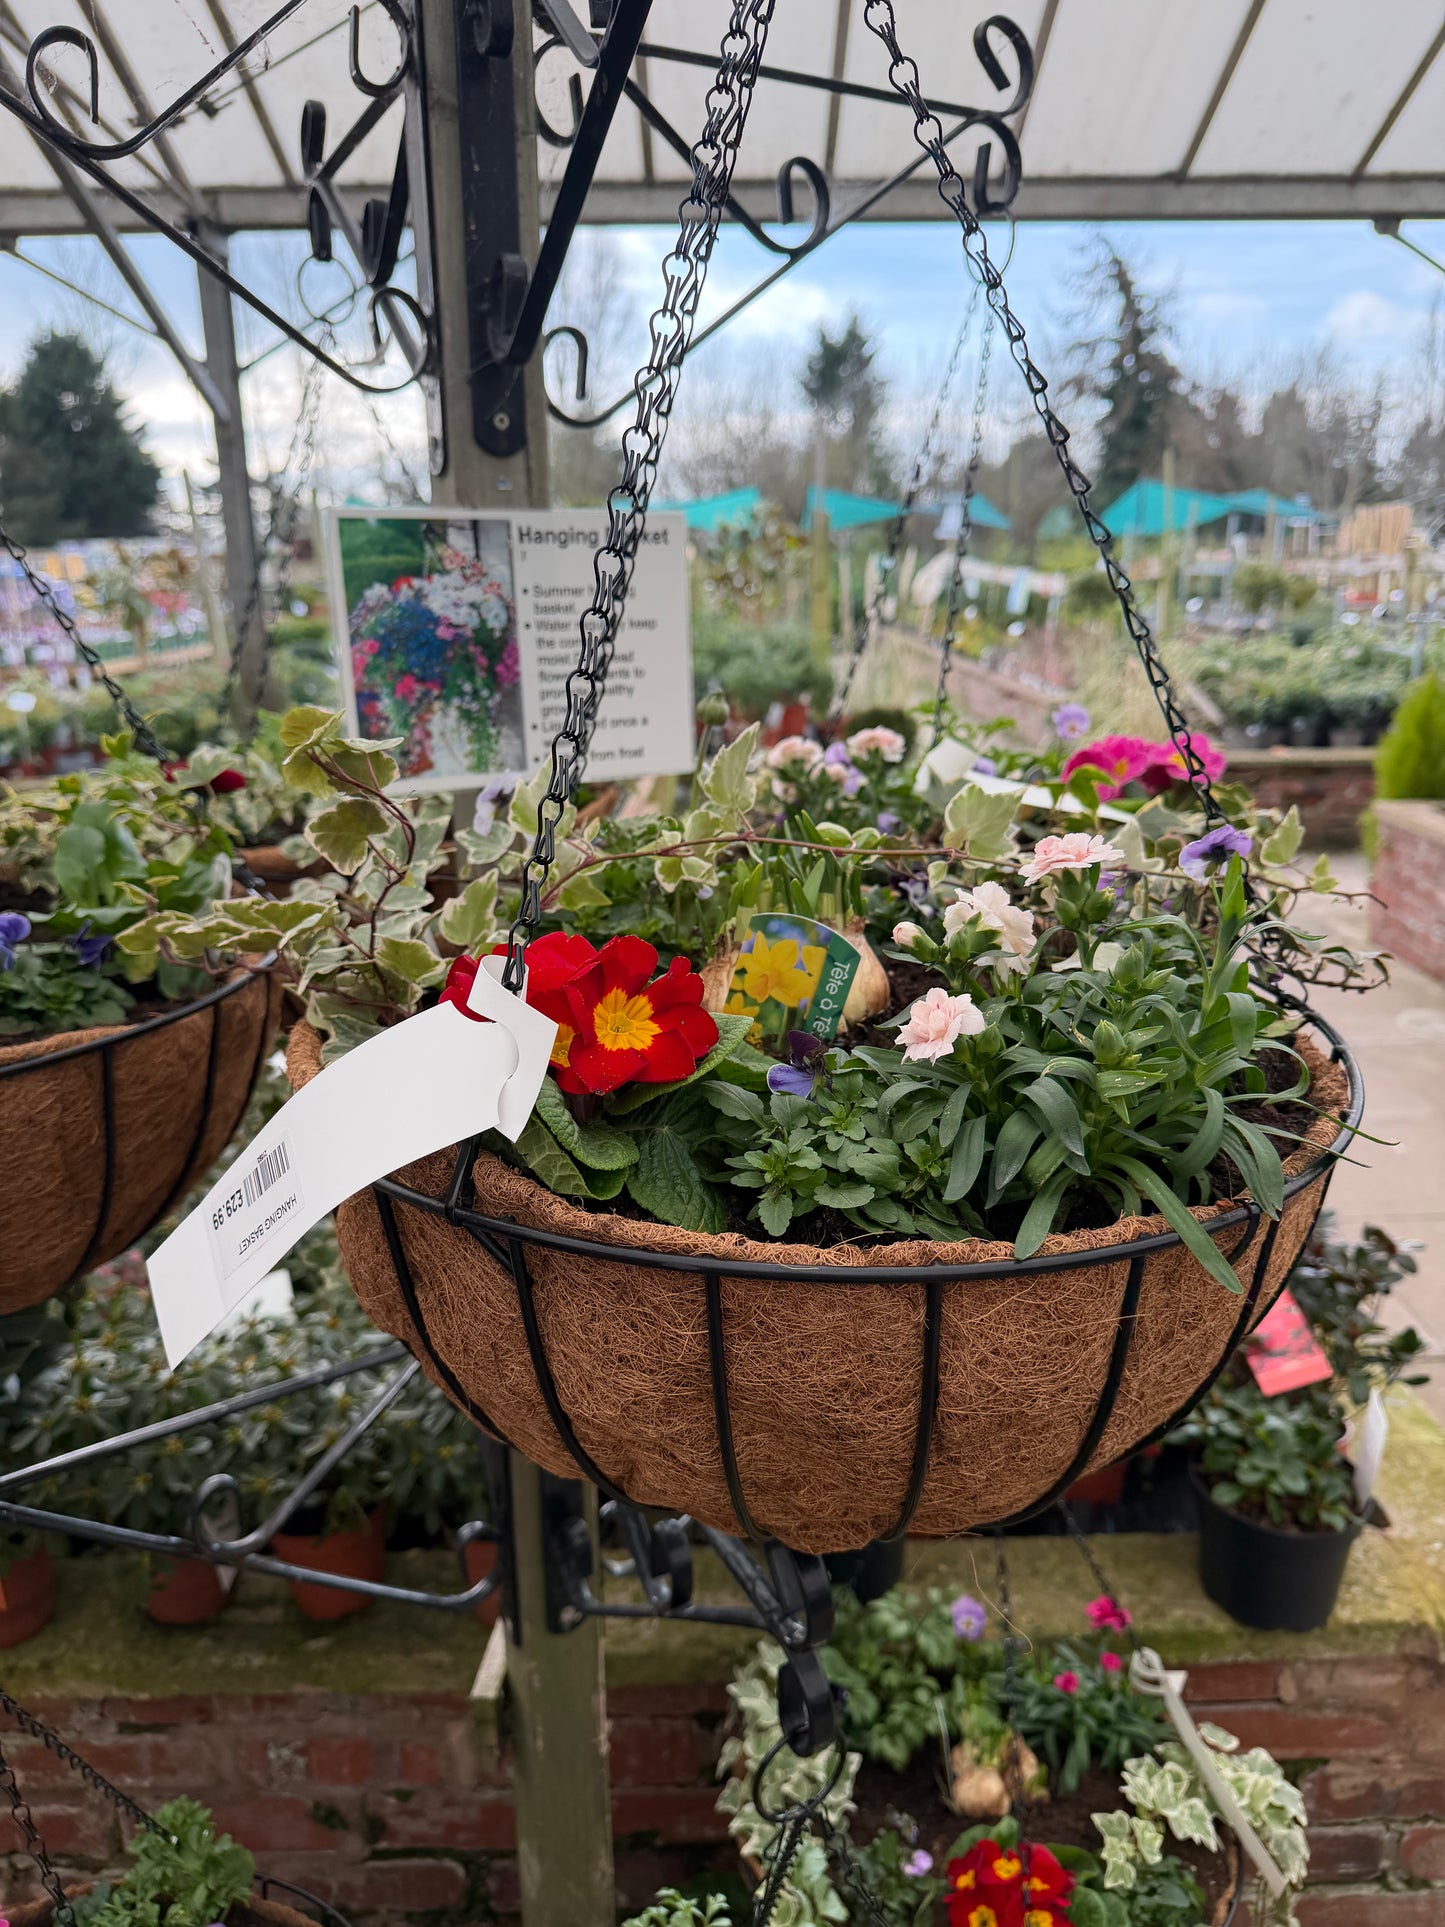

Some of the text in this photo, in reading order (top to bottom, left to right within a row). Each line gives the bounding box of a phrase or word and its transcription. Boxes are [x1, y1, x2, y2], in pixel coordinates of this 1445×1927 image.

[517, 526, 599, 548] Hanging
[532, 585, 584, 597] Summer
[825, 961, 851, 995] Tête
[812, 1015, 832, 1039] Tê
[212, 1187, 245, 1231] £29.99
[239, 1193, 298, 1256] HANGING BASKET
